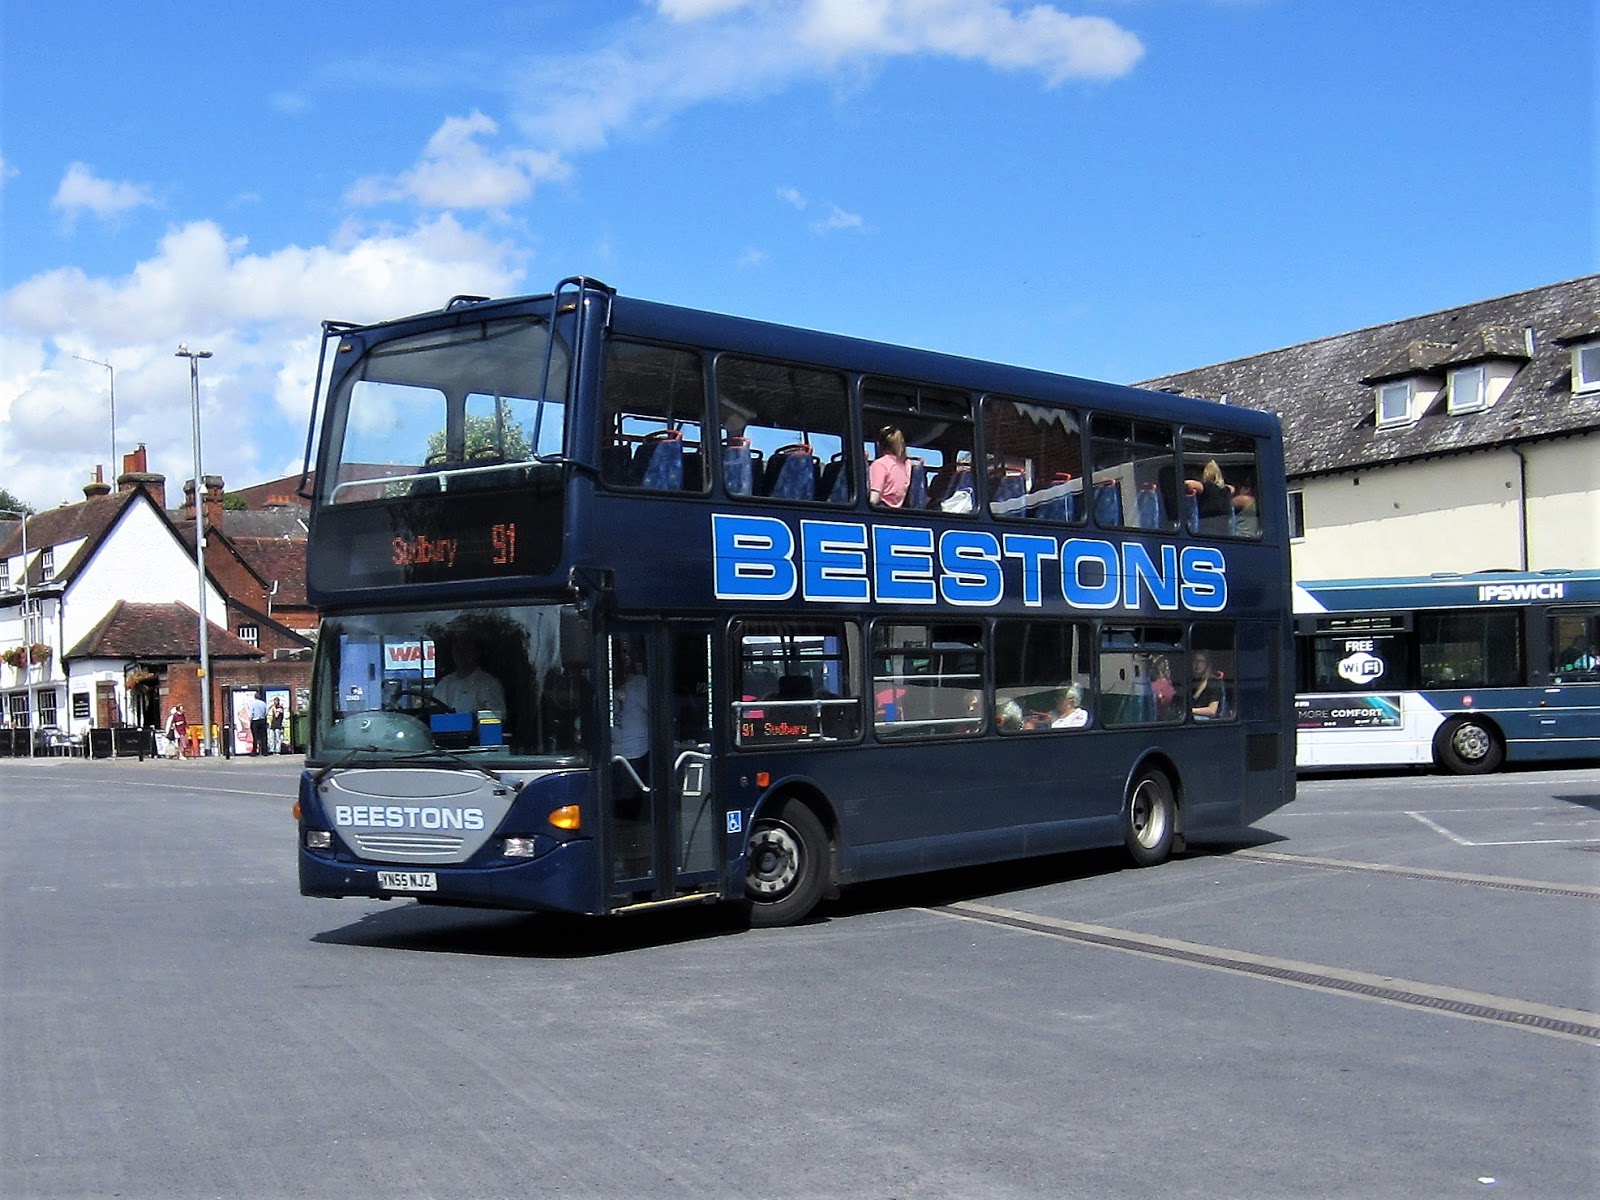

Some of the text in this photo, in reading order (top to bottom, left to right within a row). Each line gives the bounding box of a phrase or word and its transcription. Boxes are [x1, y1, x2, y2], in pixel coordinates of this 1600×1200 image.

[392, 523, 516, 568] Sudbury 91
[711, 513, 1228, 612] BEESTONS
[1478, 582, 1564, 602] IPSWICH
[1345, 640, 1374, 652] FREE
[1298, 708, 1384, 719] MORE COMFORT
[742, 722, 809, 737] 91 Sudbury
[335, 805, 485, 830] BEESTONS
[381, 873, 432, 888] YN55 NJZ
